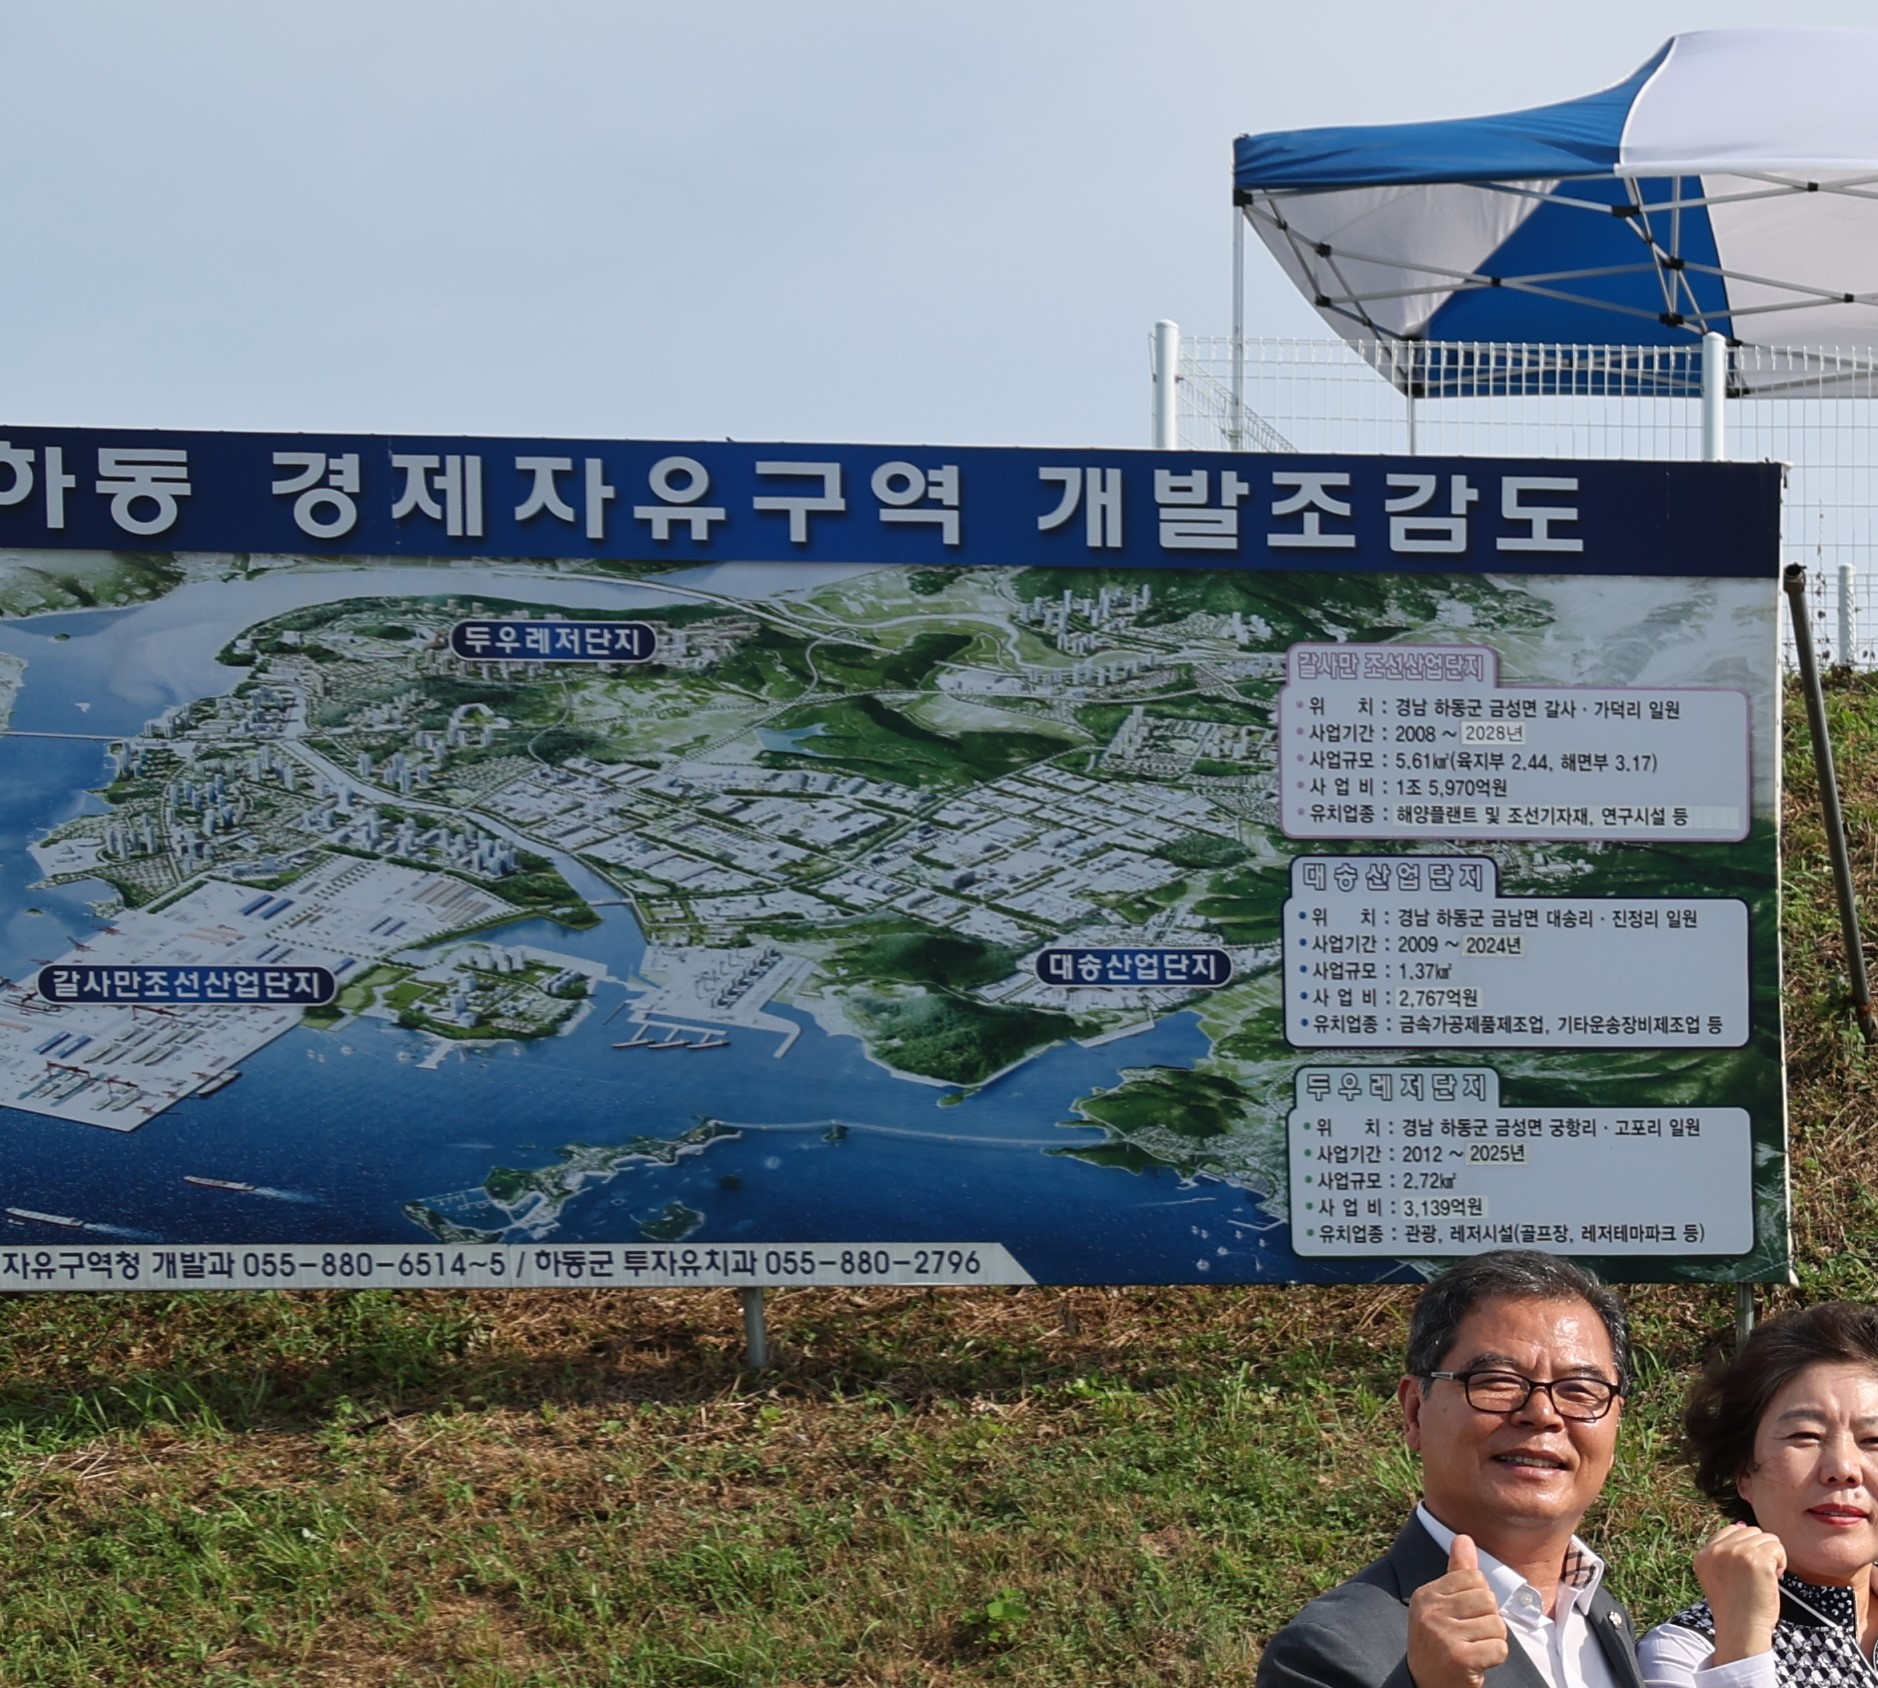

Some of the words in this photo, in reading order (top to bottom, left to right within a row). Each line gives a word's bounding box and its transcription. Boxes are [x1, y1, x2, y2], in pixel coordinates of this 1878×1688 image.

[0, 441, 192, 536] 하동
[271, 451, 960, 545] 경제자유구역
[1036, 464, 1585, 554] 개발조감도
[464, 626, 640, 656] 두우레저단지
[1298, 652, 1359, 680] 갈사만
[1364, 651, 1484, 682] 조선산업단지
[1396, 697, 1428, 717] 경남
[1434, 698, 1483, 718] 하동군
[1489, 699, 1537, 719] 금성면
[1544, 699, 1577, 719] 갈사
[1594, 700, 1641, 720] 가덕리
[1648, 700, 1680, 720] 일원
[1309, 723, 1375, 743] 사업기간
[1395, 725, 1436, 743] 2008
[1465, 725, 1523, 742] 2028년
[1309, 750, 1375, 770] 사업규모
[1561, 753, 1609, 772] 해면부
[1615, 753, 1657, 773] 3.17)
[1396, 779, 1422, 796] 1조
[1429, 778, 1507, 798] 5,970억원
[1310, 804, 1375, 824] 유치업종
[1397, 805, 1478, 825] 해양플랜트
[1485, 806, 1500, 825] 및
[1507, 806, 1594, 826] 조선기자재,
[1601, 807, 1665, 826] 연구시설
[1672, 807, 1689, 827] 등
[1302, 863, 1483, 892] 대송산업단지
[1398, 908, 1430, 928] 경남
[1436, 908, 1485, 928] 하동군
[1491, 909, 1539, 928] 금남면
[1546, 909, 1593, 929] 대송리
[1612, 909, 1658, 929] 진정리
[1666, 909, 1697, 929] 일원
[1312, 934, 1377, 954] 사업기간
[1398, 935, 1439, 953] 2009
[1466, 936, 1521, 955] 2024년
[1049, 954, 1217, 981] 대송산업단지
[1312, 961, 1377, 981] 사업규모
[52, 970, 321, 999] 갈사만조선산업단지
[1399, 988, 1478, 1008] 2,767억원
[1313, 1014, 1378, 1034] 유치업종
[1399, 1014, 1550, 1035] 금속가공제품제조업,
[1558, 1015, 1700, 1035] 기타운송장비제조업
[1707, 1015, 1723, 1035] 등
[1307, 1073, 1486, 1101] 두우레저단지
[1402, 1118, 1434, 1138] 경남
[1440, 1118, 1489, 1138] 하동군
[1494, 1118, 1542, 1138] 금성면
[1549, 1118, 1597, 1138] 궁항리
[1614, 1118, 1662, 1137] 고포리
[1669, 1117, 1700, 1138] 일원
[1317, 1145, 1382, 1164] 사업기간
[1402, 1145, 1443, 1163] 2012
[1470, 1143, 1525, 1162] 2025년
[1317, 1171, 1382, 1191] 사업규모
[1404, 1197, 1483, 1218] 3,139억원
[1319, 1224, 1384, 1244] 유치업종
[1404, 1224, 1442, 1244] 관광,
[1581, 1224, 1677, 1243] 레저테마파크
[1683, 1223, 1705, 1243] 등)
[3, 1251, 140, 1280] 자유구역청
[152, 1251, 235, 1279] 개발과
[243, 1251, 505, 1279] 055-880-6514~5
[534, 1250, 614, 1278] 하동군
[624, 1250, 758, 1277] 투자유치과
[765, 1250, 981, 1275] 055-880-2796
